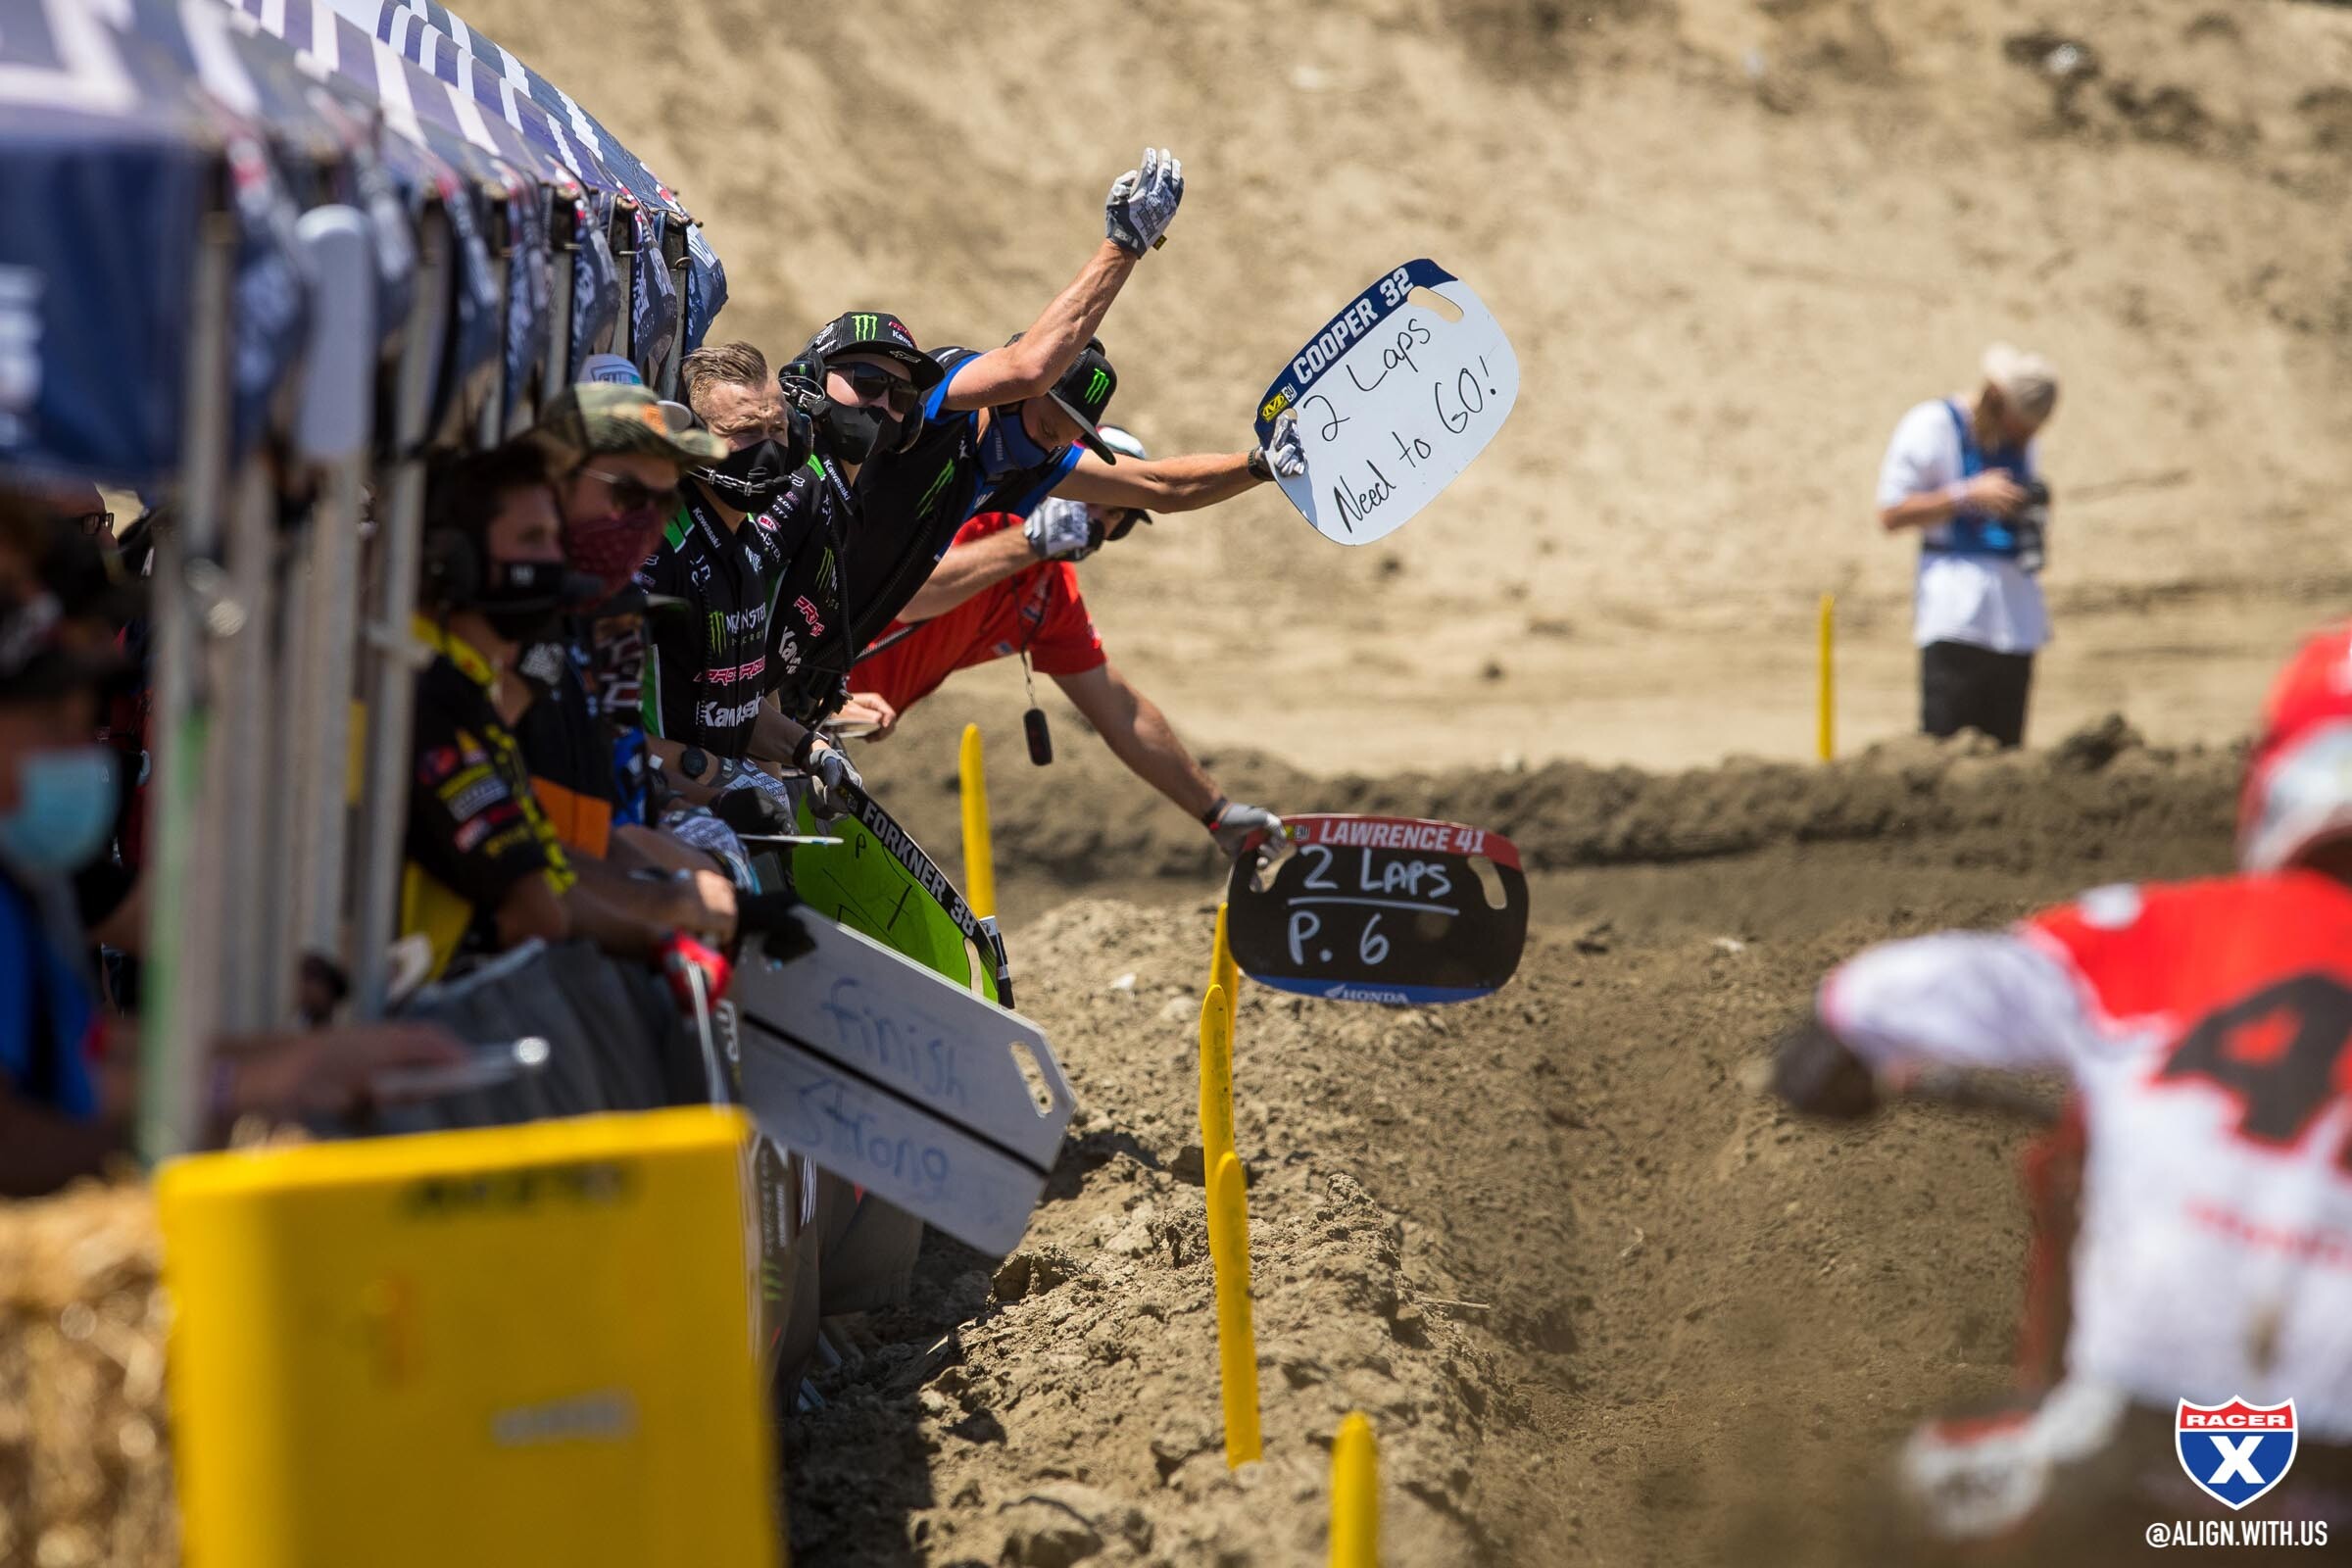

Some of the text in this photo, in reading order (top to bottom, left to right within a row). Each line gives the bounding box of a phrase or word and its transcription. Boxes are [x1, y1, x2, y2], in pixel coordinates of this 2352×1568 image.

[1293, 267, 1414, 384] COOPER 32
[1302, 318, 1432, 442] 2 Laps
[1333, 355, 1497, 534] Need to GO!
[823, 458, 852, 502] Kawasaki
[692, 507, 721, 549] Kawasaki
[1319, 820, 1452, 851] LAWRENCE
[1454, 828, 1485, 855] 41
[862, 800, 978, 938] FORKNER 38
[1301, 844, 1339, 890] 2
[1288, 909, 1390, 966] P. 6
[1343, 989, 1409, 1004] HONDA
[2154, 970, 2352, 1181] 4
